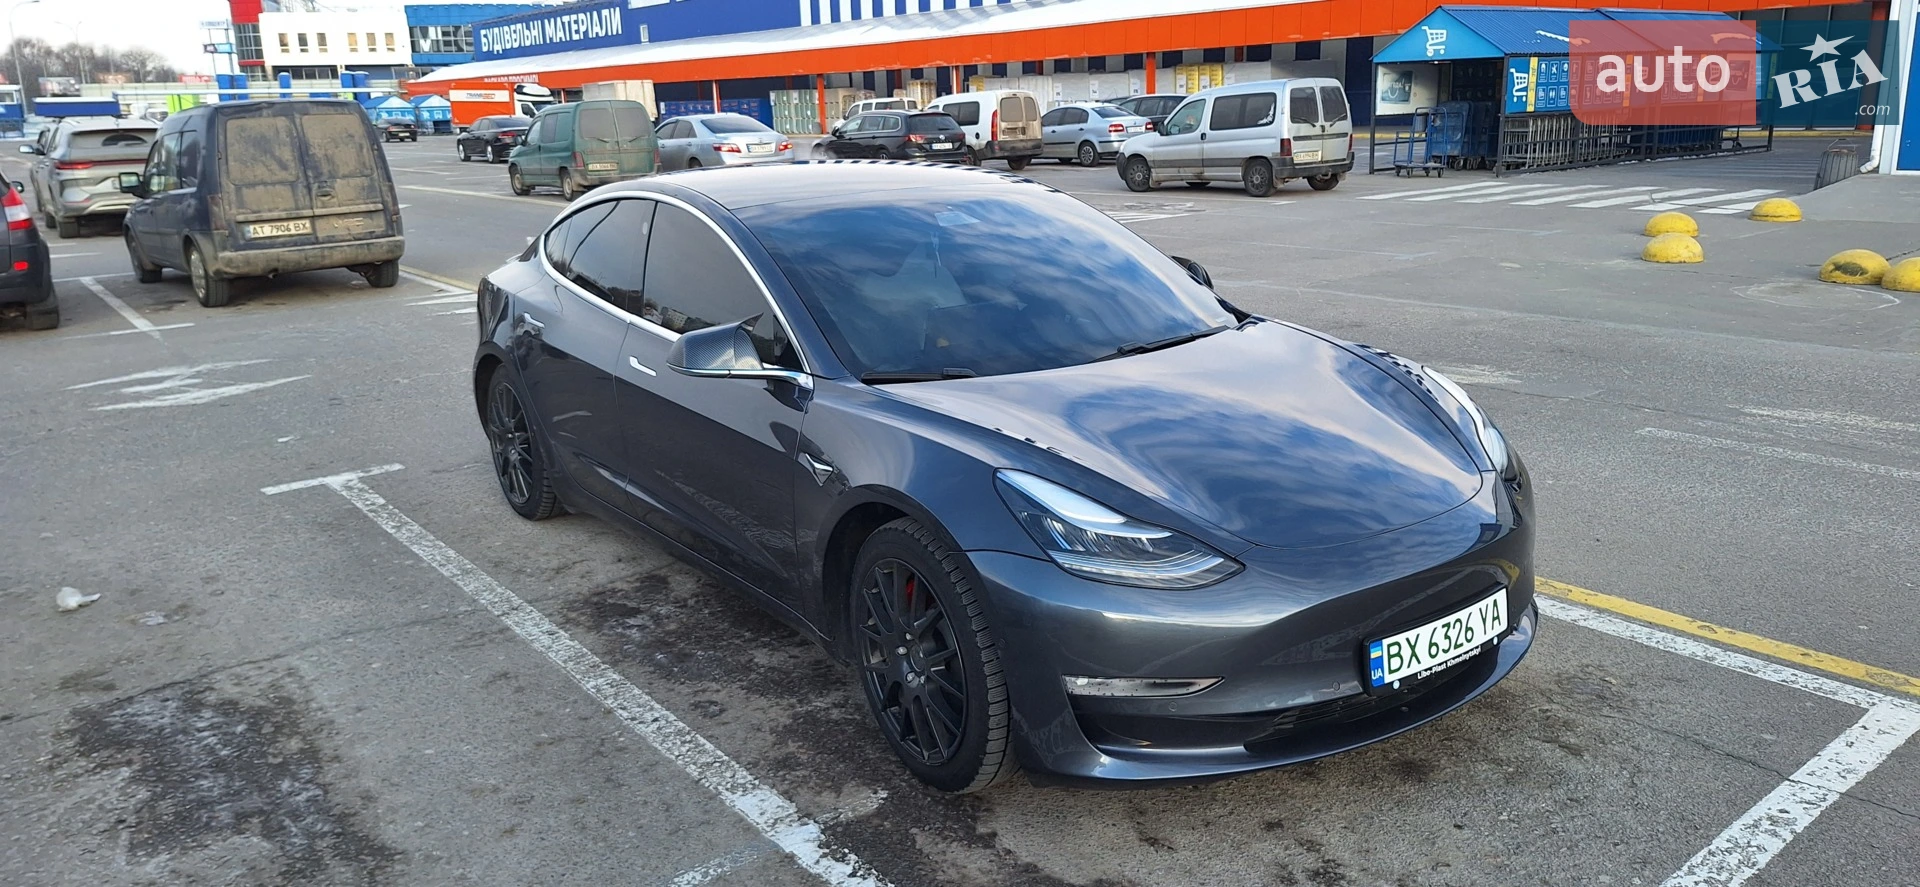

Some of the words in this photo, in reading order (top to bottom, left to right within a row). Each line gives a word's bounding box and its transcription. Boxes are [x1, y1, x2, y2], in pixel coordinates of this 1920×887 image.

[480, 20, 543, 54] БУДІВЕЛЬНІ
[544, 7, 622, 44] МАТЕРІАЛИ
[252, 226, 265, 235] AT
[269, 223, 291, 233] 7906
[294, 221, 308, 231] BX
[1387, 633, 1421, 675] BX
[1428, 611, 1474, 659] 6326
[1479, 598, 1501, 635] YA
[1371, 668, 1383, 680] UA
[1417, 663, 1447, 679] Libo-Plast
